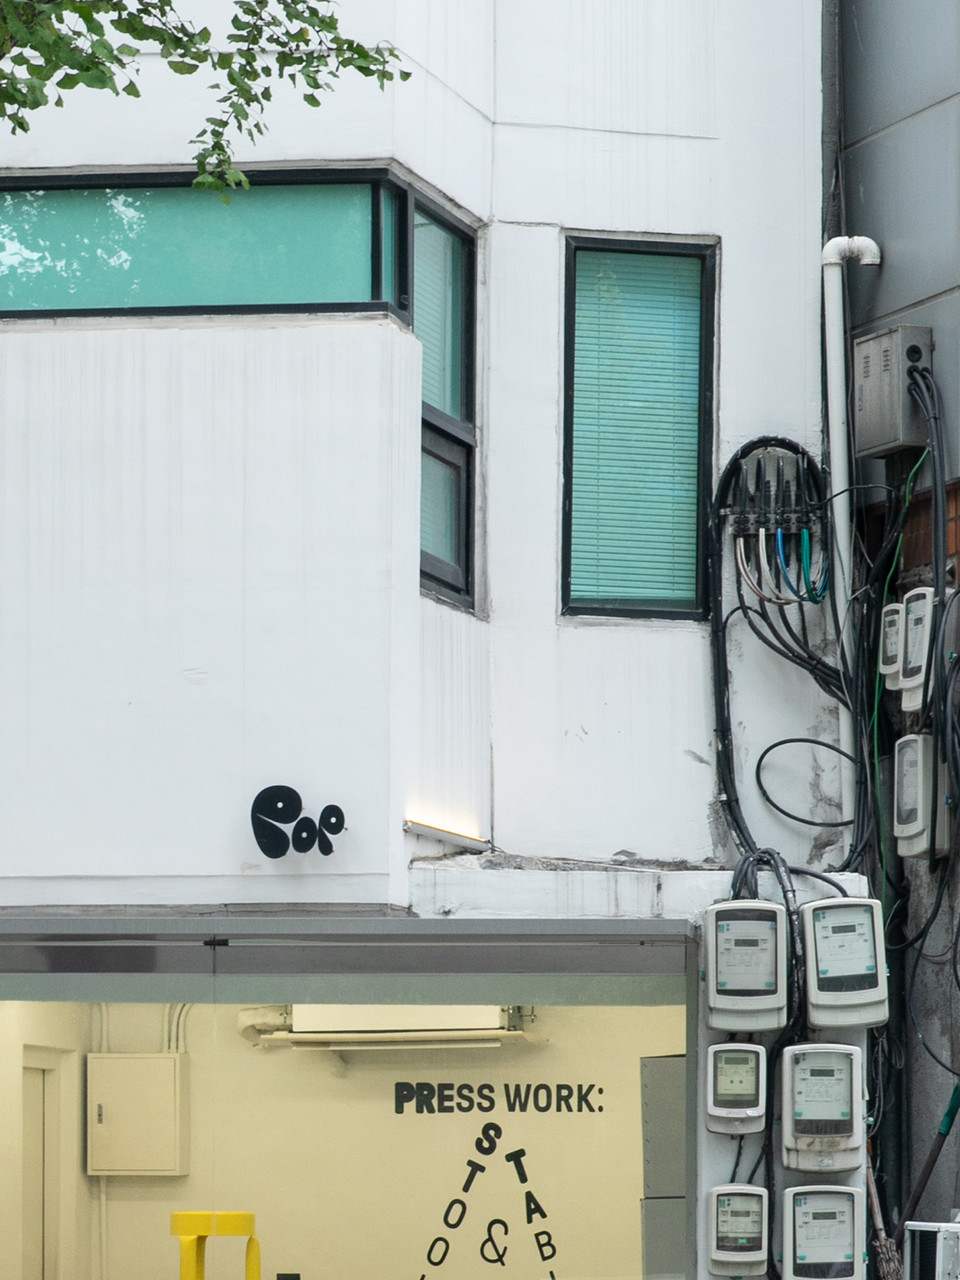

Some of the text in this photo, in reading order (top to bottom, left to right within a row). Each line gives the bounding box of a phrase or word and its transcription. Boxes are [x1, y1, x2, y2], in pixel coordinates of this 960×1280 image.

[394, 1082, 604, 1114] PRESS WORK:
[480, 1218, 509, 1267] &
